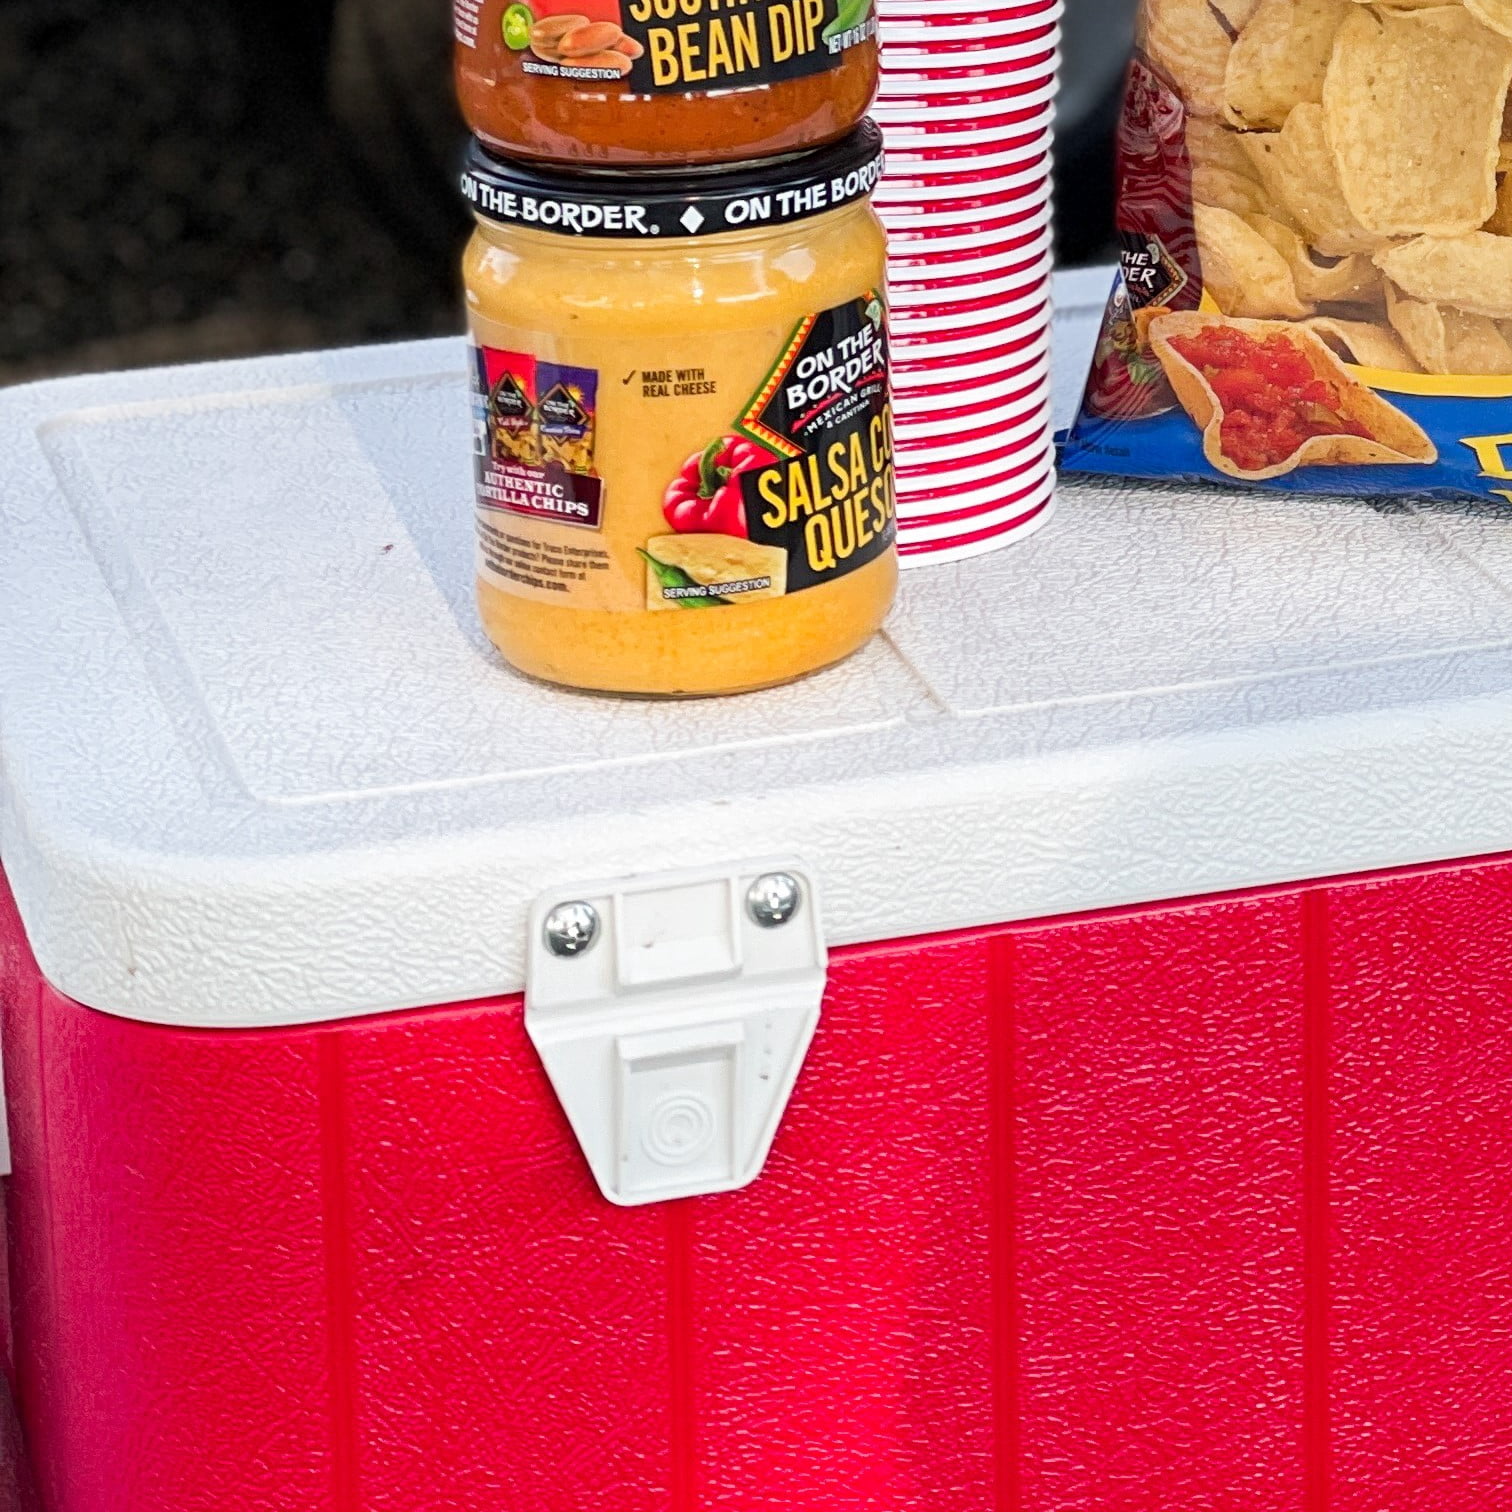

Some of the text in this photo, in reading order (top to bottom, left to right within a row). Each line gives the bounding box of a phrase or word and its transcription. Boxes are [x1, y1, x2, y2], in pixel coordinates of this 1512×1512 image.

[648, 11, 760, 86] BEAN
[522, 62, 621, 79] SERVING SUGGESTION
[461, 173, 648, 234] ON THE BORDER
[725, 196, 770, 224] ON
[776, 183, 827, 216] THE
[1121, 250, 1148, 266] THE
[1122, 267, 1157, 289] DER
[796, 323, 873, 379] ON THE
[642, 368, 705, 383] MADE WITH
[786, 338, 885, 409] BORDER
[643, 381, 716, 397] REAL CHEESE
[806, 393, 858, 433] MEXICAN
[835, 399, 870, 425] CANTINA
[506, 465, 525, 476] with
[758, 403, 892, 529] SALSA CO
[484, 471, 563, 498] AUTHENTIC
[531, 496, 589, 517] CHIPS
[804, 462, 894, 572] QUESO
[663, 577, 770, 599] SERVING SUGGESTION
